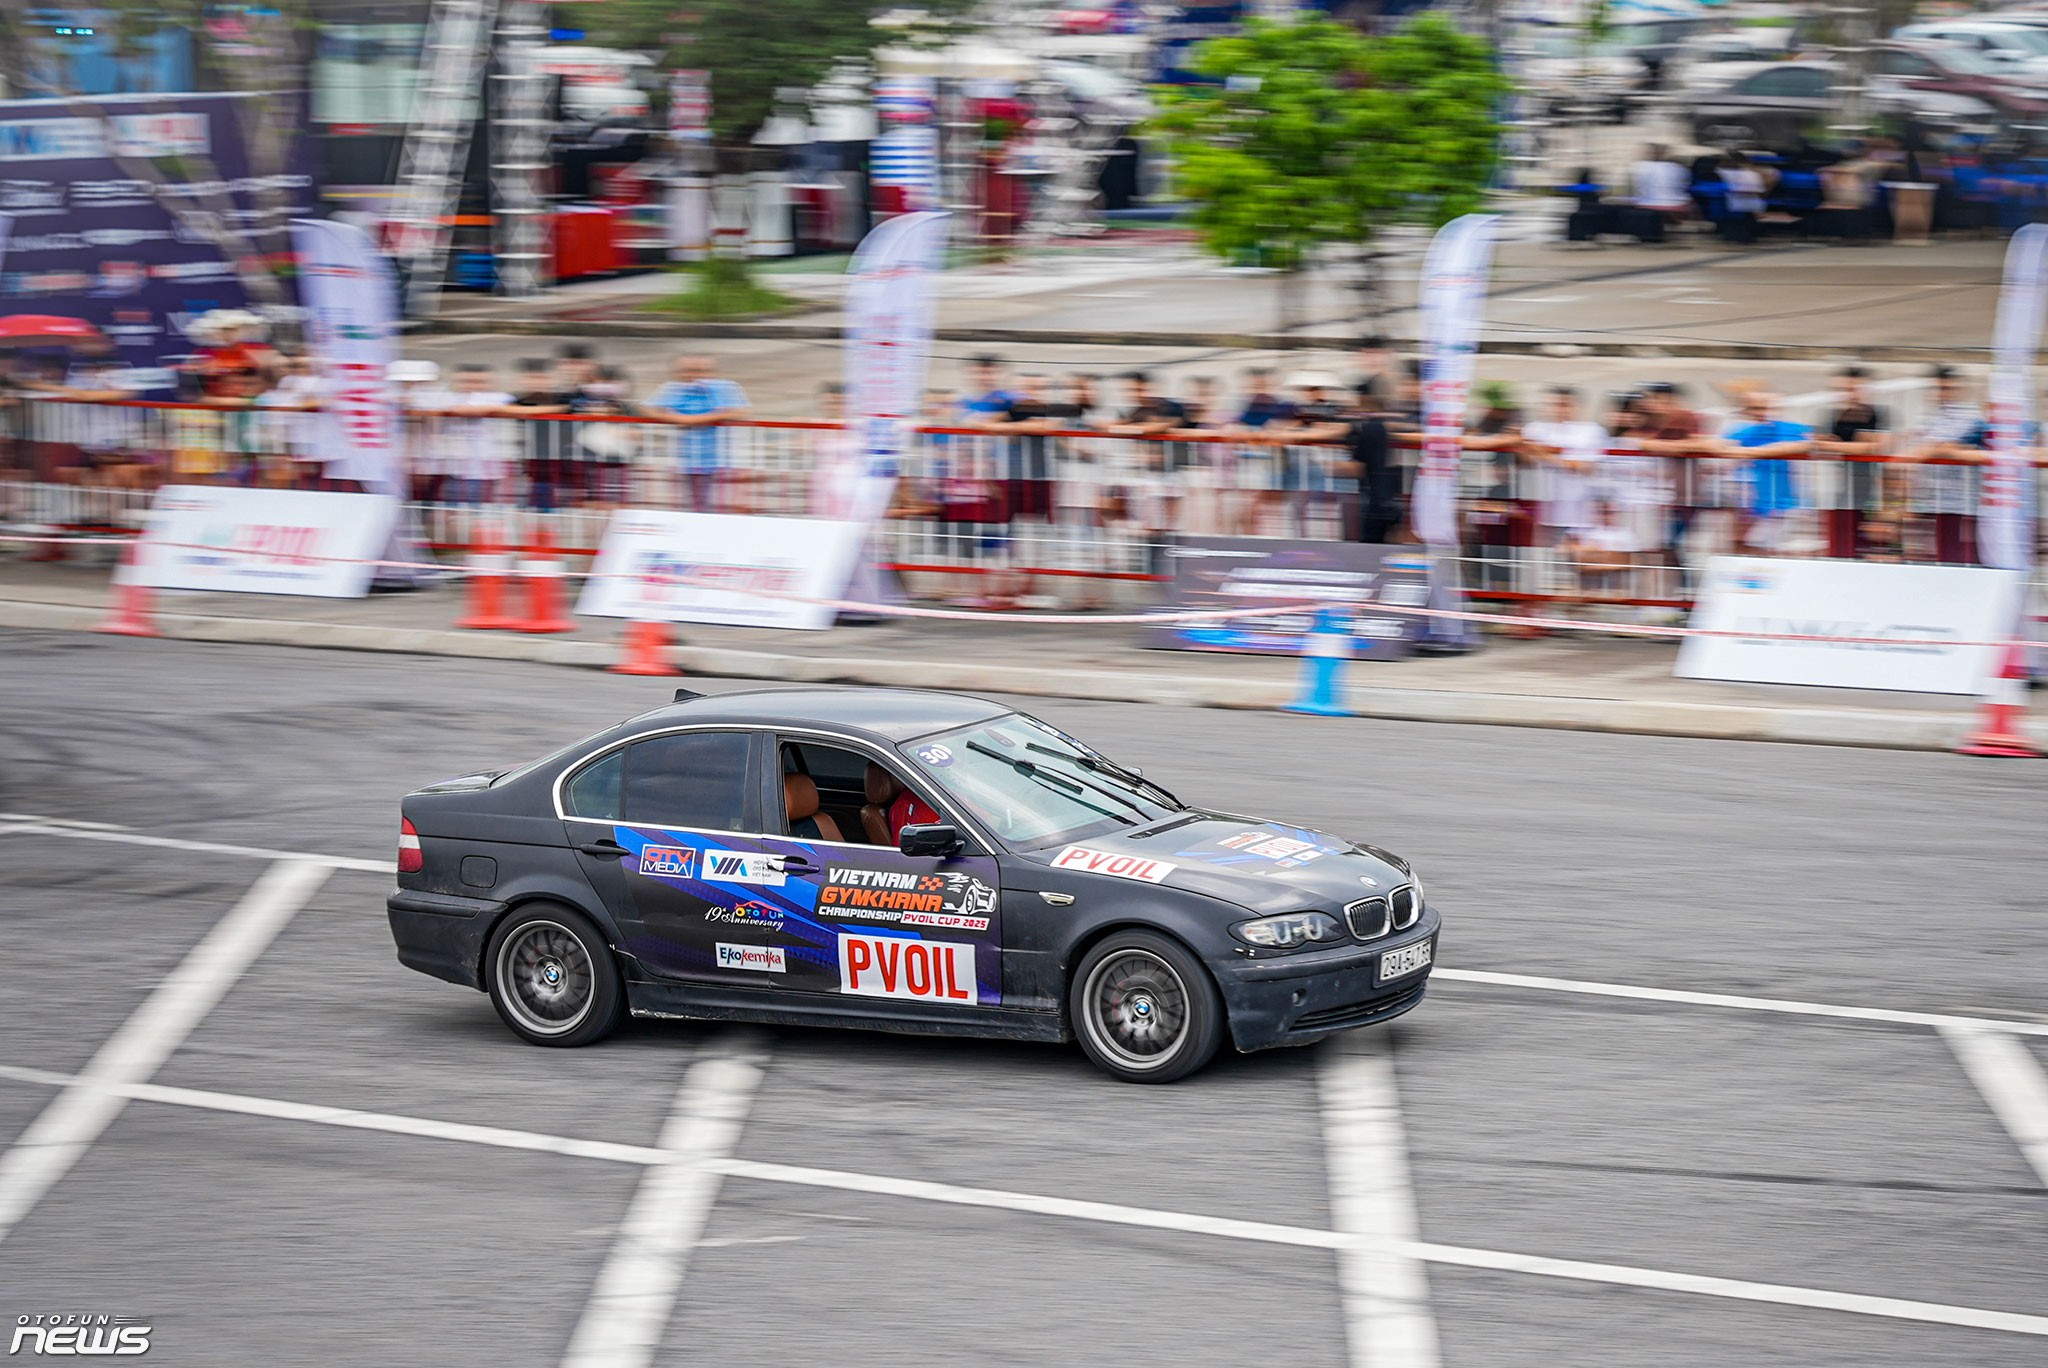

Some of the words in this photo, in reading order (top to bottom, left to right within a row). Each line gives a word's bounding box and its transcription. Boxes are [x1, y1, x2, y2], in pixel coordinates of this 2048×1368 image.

[920, 748, 949, 764] 30
[645, 848, 692, 863] OTV
[1059, 849, 1158, 879] PVOIL
[644, 861, 689, 876] MEDIA
[828, 868, 918, 890] VIETNAM
[821, 887, 943, 912] GYMKHANA
[818, 906, 901, 921] CHAMPIONSHIP
[903, 913, 935, 924] PVOIL
[938, 917, 960, 926] CUP
[963, 919, 987, 928] 2025
[720, 947, 782, 968] Ekokemika
[847, 939, 968, 999] PVOIL
